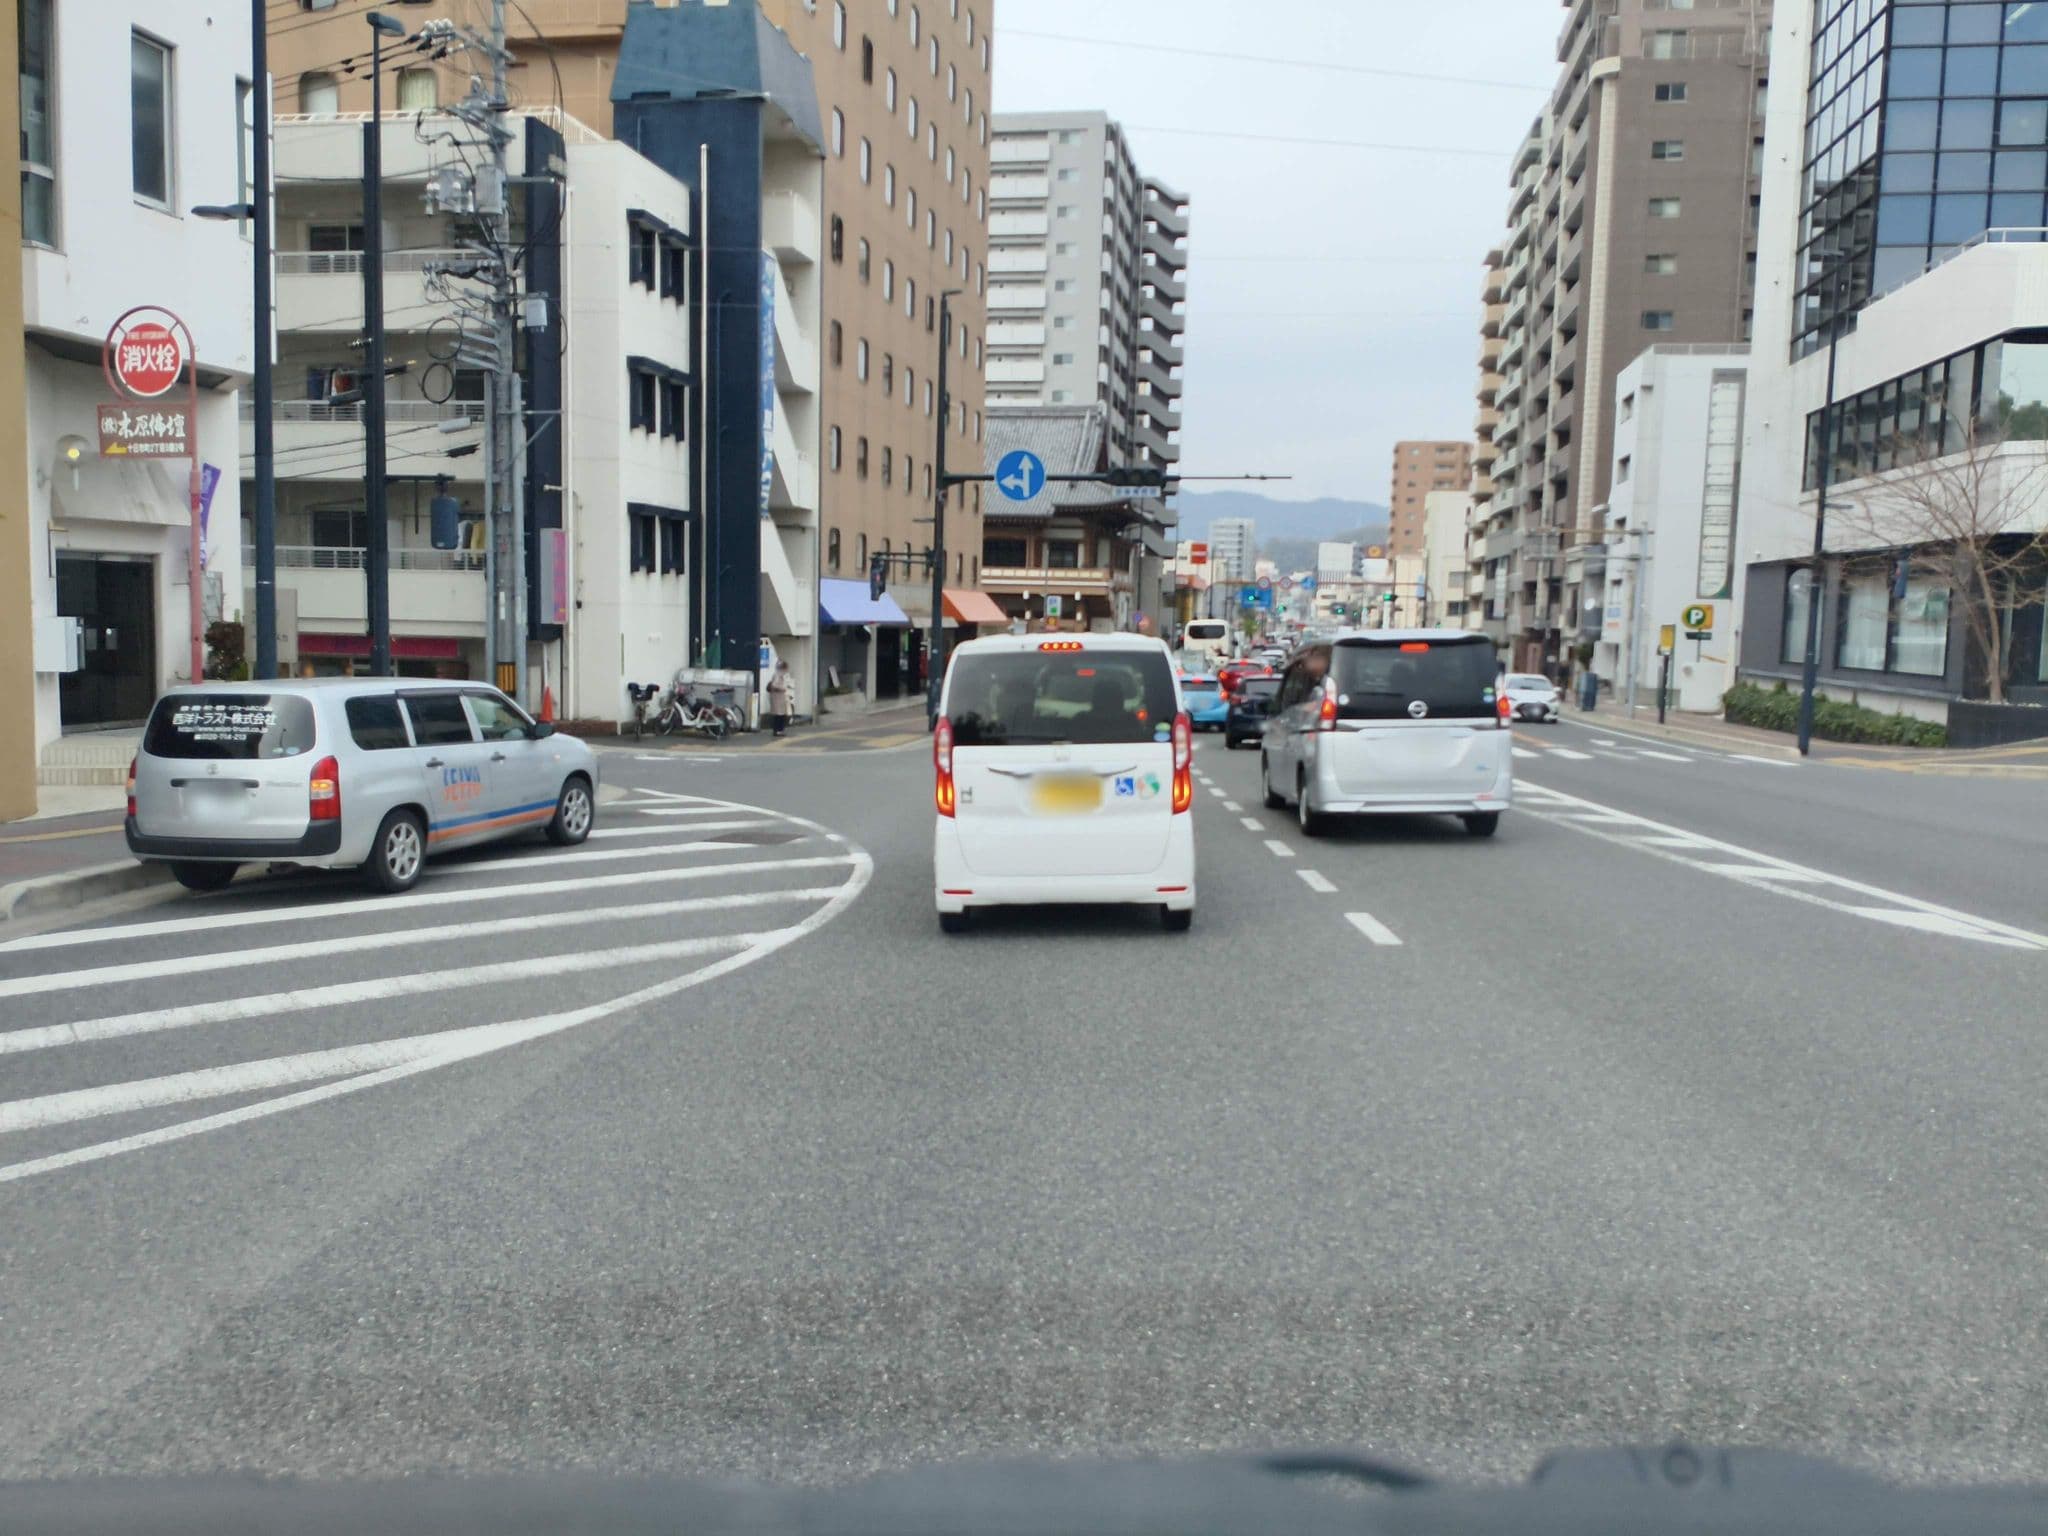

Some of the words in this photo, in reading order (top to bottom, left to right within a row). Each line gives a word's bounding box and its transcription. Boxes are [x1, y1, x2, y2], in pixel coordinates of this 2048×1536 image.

[123, 344, 175, 372] 消火栓
[1690, 609, 1704, 625] P
